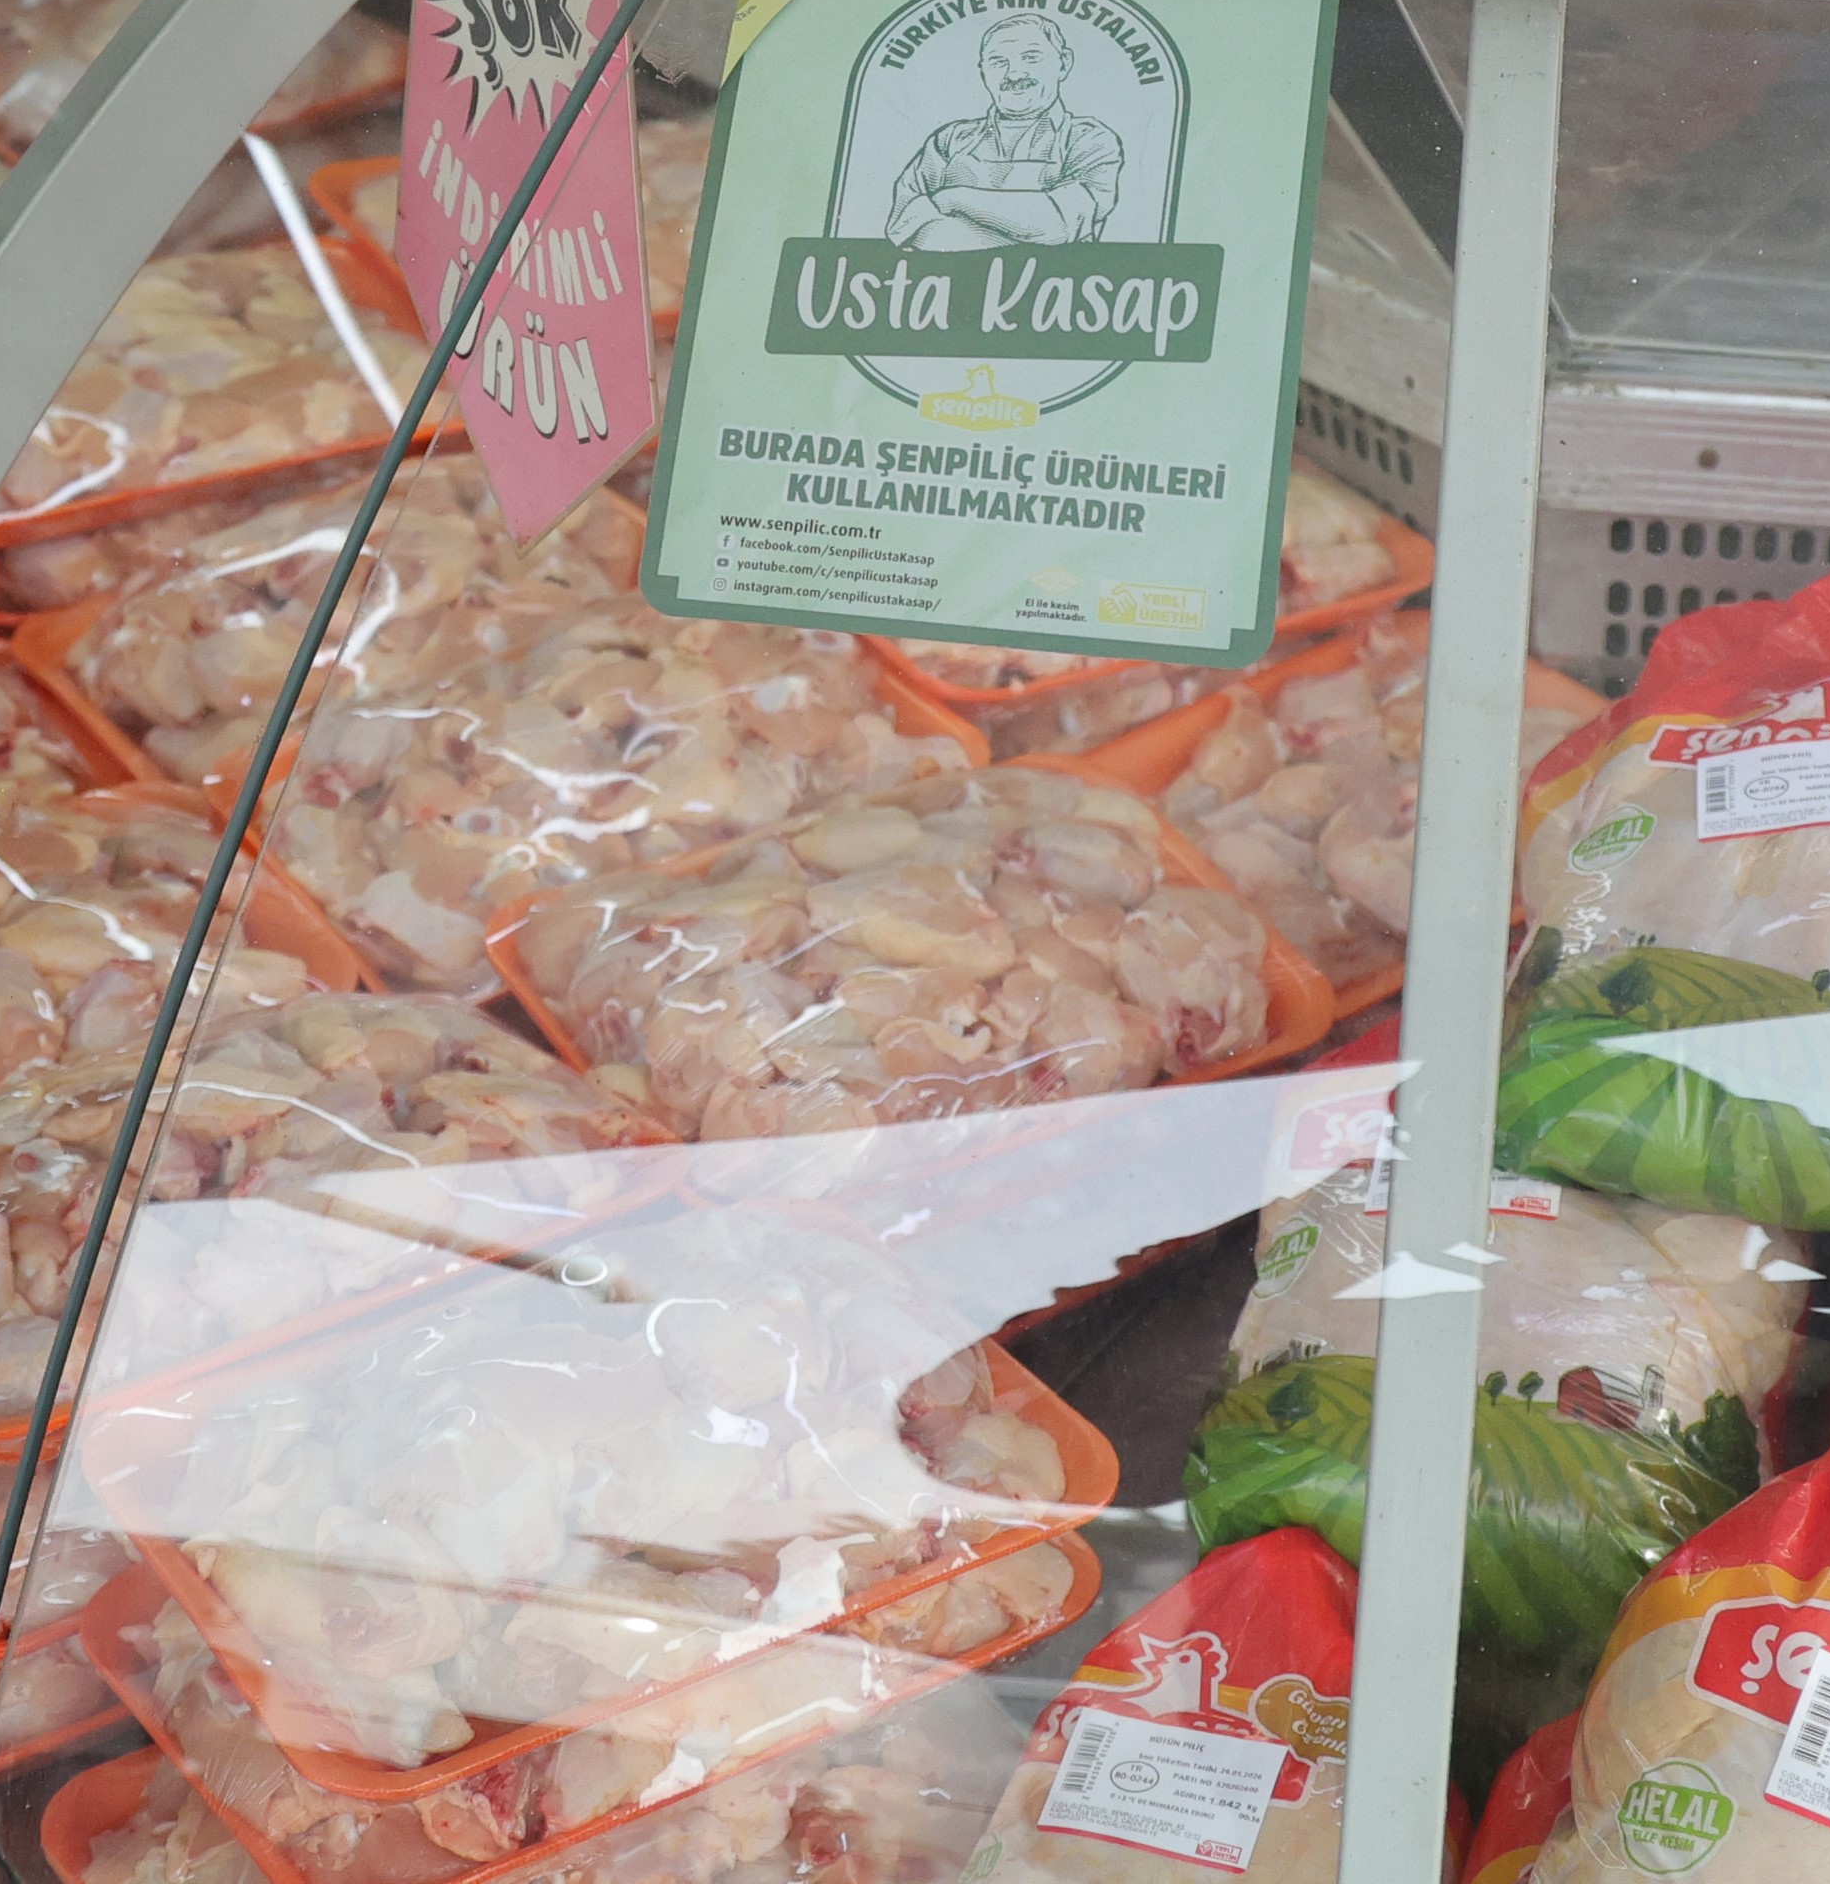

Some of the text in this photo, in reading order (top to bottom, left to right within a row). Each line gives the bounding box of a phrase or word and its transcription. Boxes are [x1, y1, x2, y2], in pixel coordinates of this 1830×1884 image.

[797, 256, 1199, 357] Usta Kasap
[438, 246, 608, 443] ÜRÜN
[719, 428, 1227, 500] BURADA ŞENPİLİÇ ÜRÜNLERİ
[786, 473, 1146, 533] KULLANILMAKTADIR
[720, 515, 882, 540] www.senpilic.com.tr
[739, 537, 935, 567] facebook.com/SenpilicUstaKasap
[737, 559, 938, 589] youtube.com/c/senpilicustakasap
[733, 580, 942, 611] instagram.com/senpilicustakasap/
[1050, 600, 1080, 611] kesim
[1288, 1689, 1346, 1729] Güven
[1149, 1736, 1206, 1753] BÜTÜN PİLİÇ
[1114, 1772, 1154, 1786] 80-0244
[1130, 1765, 1142, 1773] TR
[1199, 1778, 1212, 1787] NO
[1209, 1797, 1242, 1809] 1.842
[1625, 1787, 1720, 1835] HELAL
